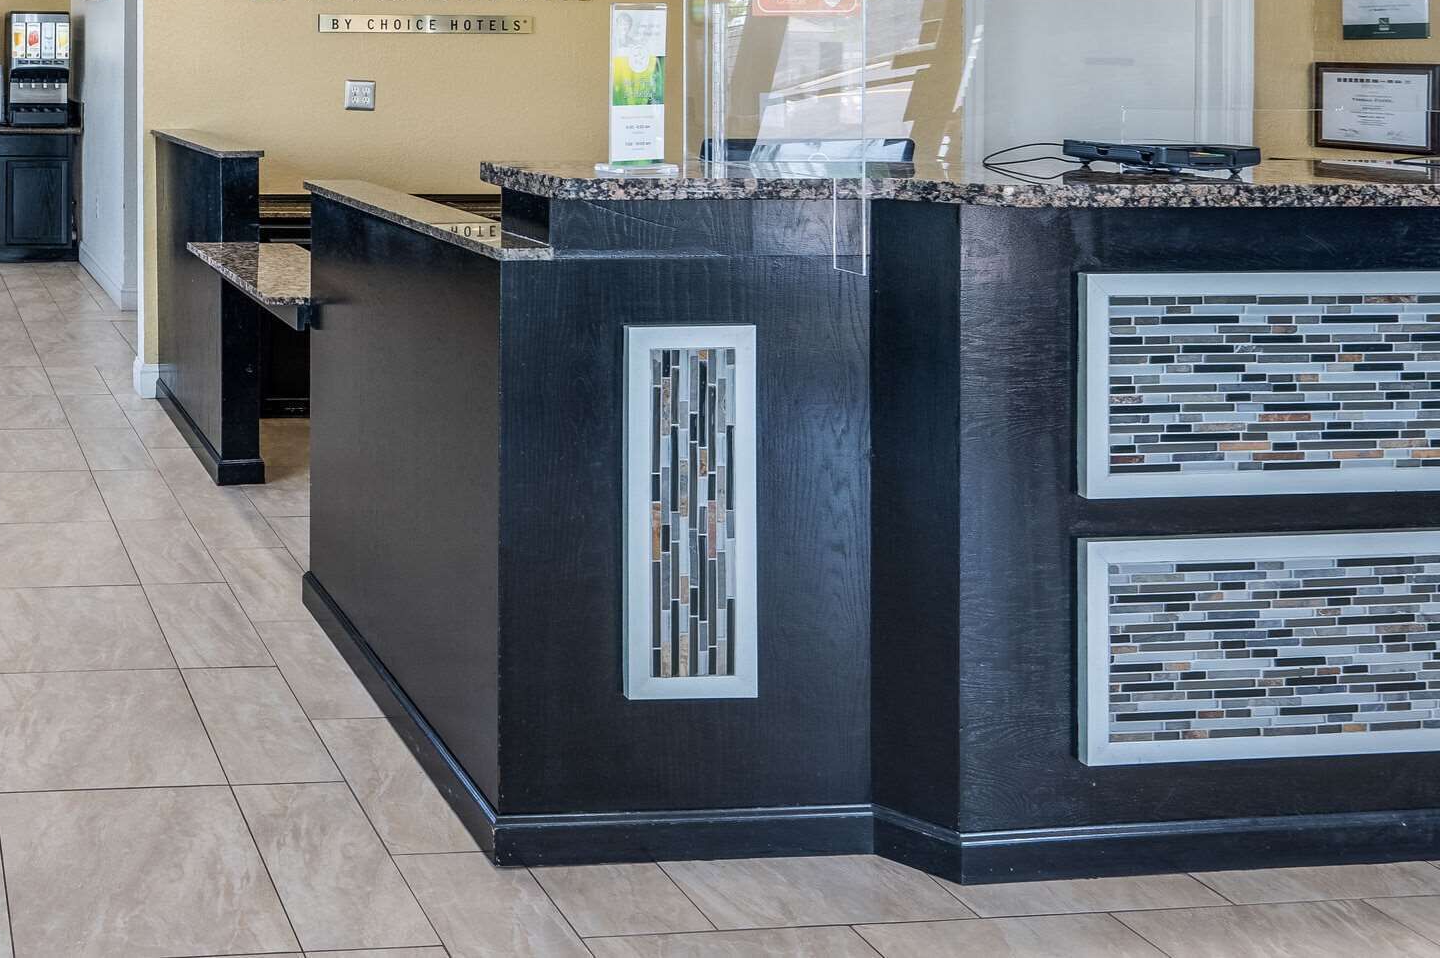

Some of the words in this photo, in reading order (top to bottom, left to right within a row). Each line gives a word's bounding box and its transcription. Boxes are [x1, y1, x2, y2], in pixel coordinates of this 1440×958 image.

[331, 18, 353, 30] BY
[366, 18, 438, 31] CHOICE
[449, 18, 522, 32] HOTELS
